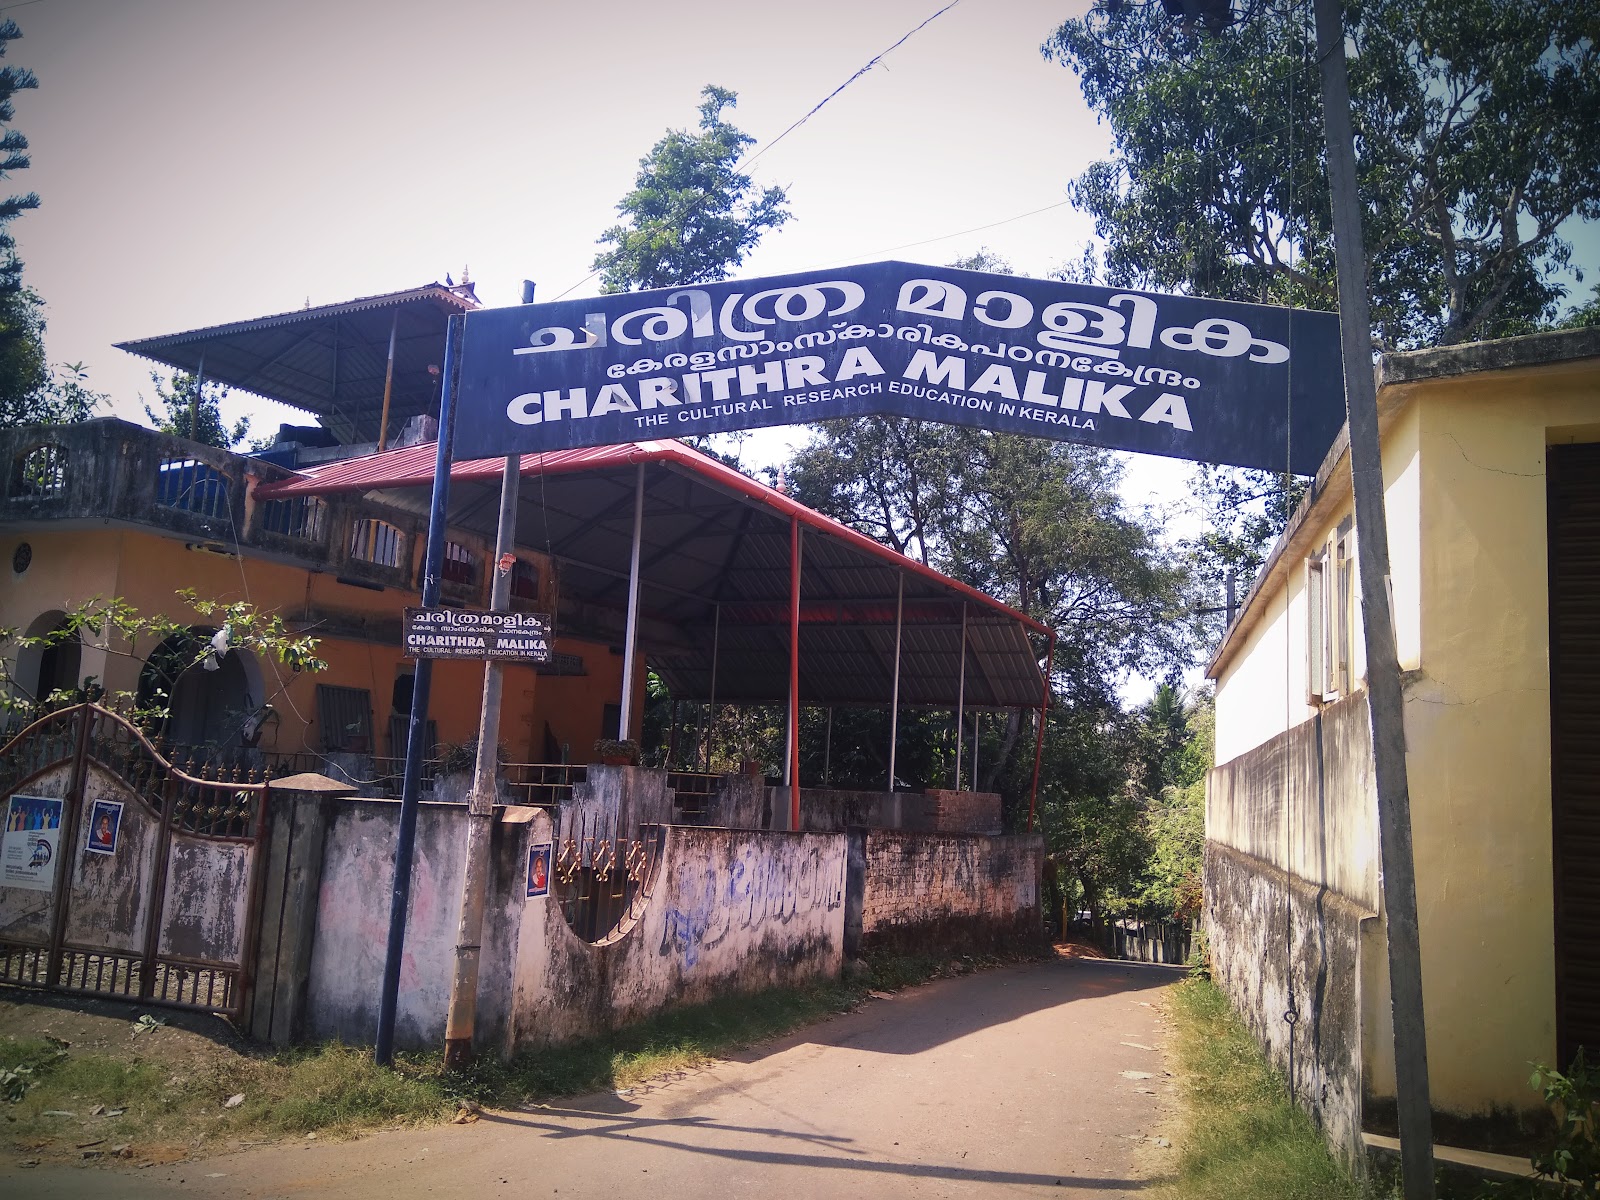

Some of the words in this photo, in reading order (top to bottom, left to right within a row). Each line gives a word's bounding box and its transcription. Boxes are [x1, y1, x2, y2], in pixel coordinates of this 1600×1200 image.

[512, 279, 867, 356] ചരിത്ര
[895, 278, 1291, 365] മാളിക
[506, 345, 887, 426] CHARITHRA
[900, 347, 1195, 433] MALIKA
[634, 413, 669, 429] THE
[677, 398, 774, 423] CULTURAL
[783, 382, 884, 407] RESEARCH
[888, 380, 994, 413] EDUCATION
[998, 402, 1016, 417] IN
[1019, 406, 1096, 431] KERALA
[407, 634, 485, 647] CHARITHRA
[496, 638, 548, 650] MALIKA
[422, 646, 452, 654] CULTURAL
[454, 647, 485, 655] RESEARCH
[526, 650, 548, 658] KERALA
